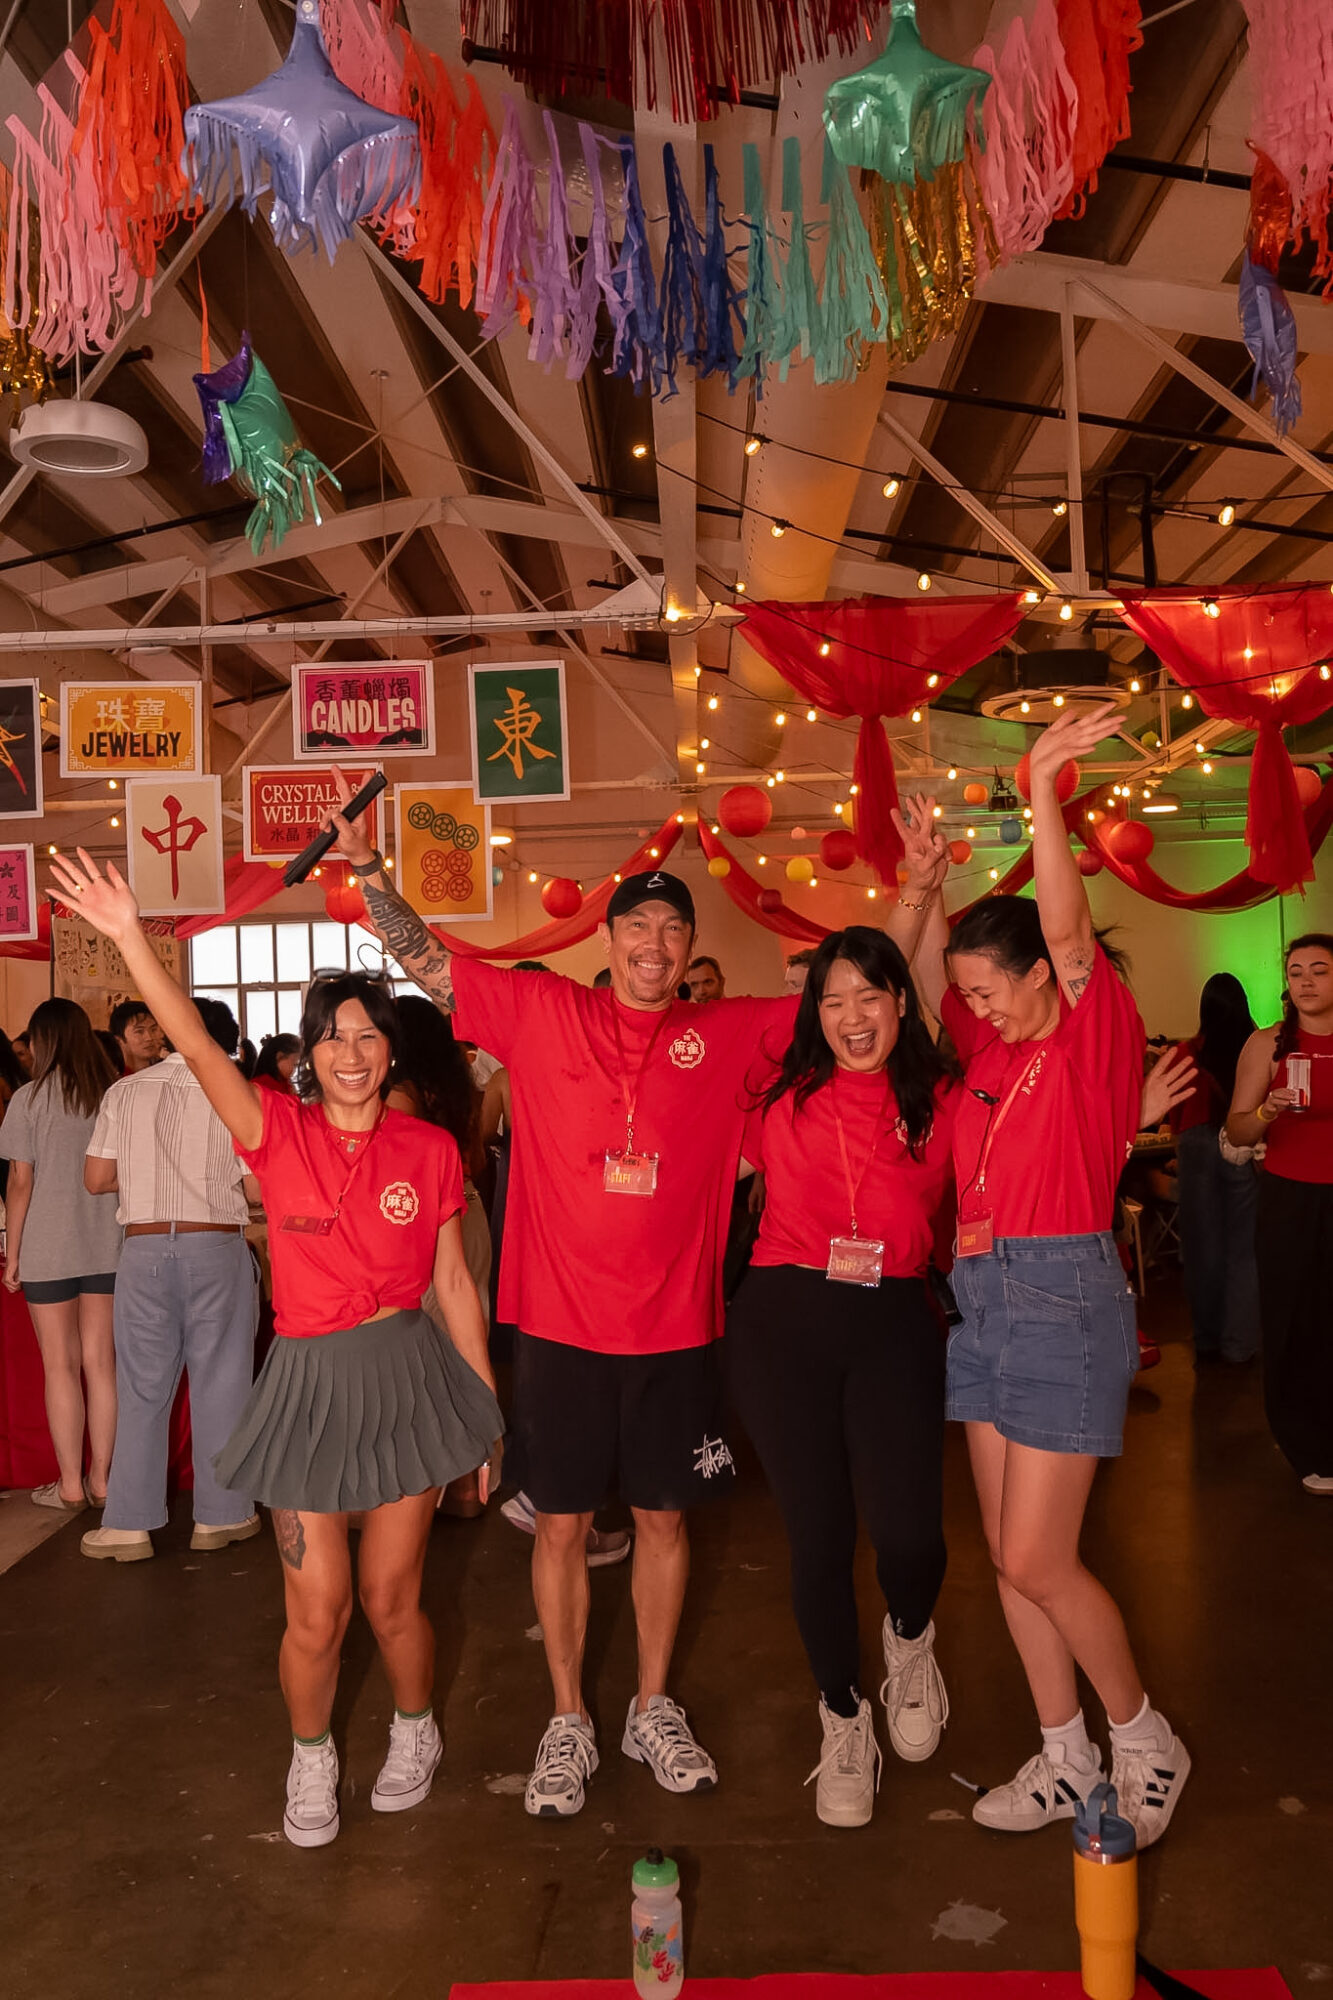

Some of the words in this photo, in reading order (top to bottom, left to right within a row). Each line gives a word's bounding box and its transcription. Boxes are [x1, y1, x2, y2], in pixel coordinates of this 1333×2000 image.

[311, 697, 416, 734] CANDLES
[486, 687, 557, 780] 東
[82, 731, 181, 758] JEWELRY
[262, 804, 342, 824] WELLN
[141, 794, 208, 900] 中
